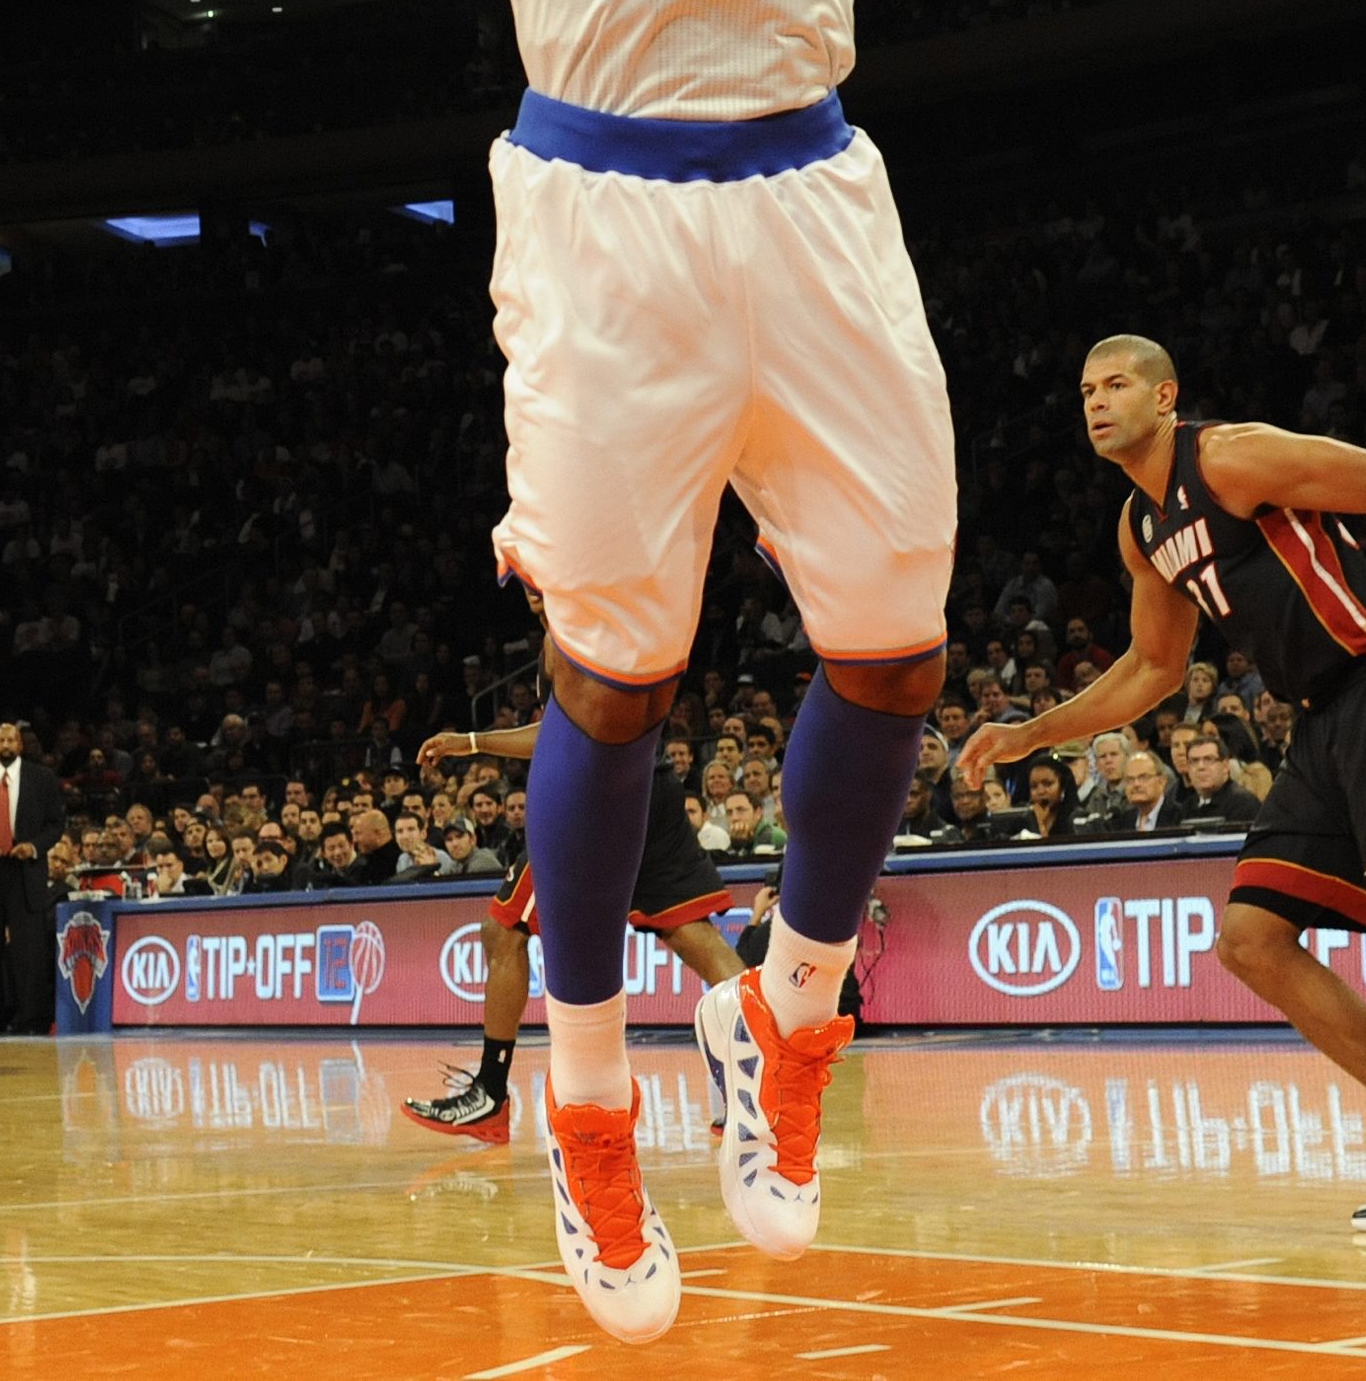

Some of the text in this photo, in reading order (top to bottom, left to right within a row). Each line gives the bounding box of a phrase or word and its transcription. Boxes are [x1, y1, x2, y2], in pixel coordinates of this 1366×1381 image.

[133, 950, 170, 988] KIA
[453, 940, 488, 985] KI
[987, 921, 1063, 974] KIA
